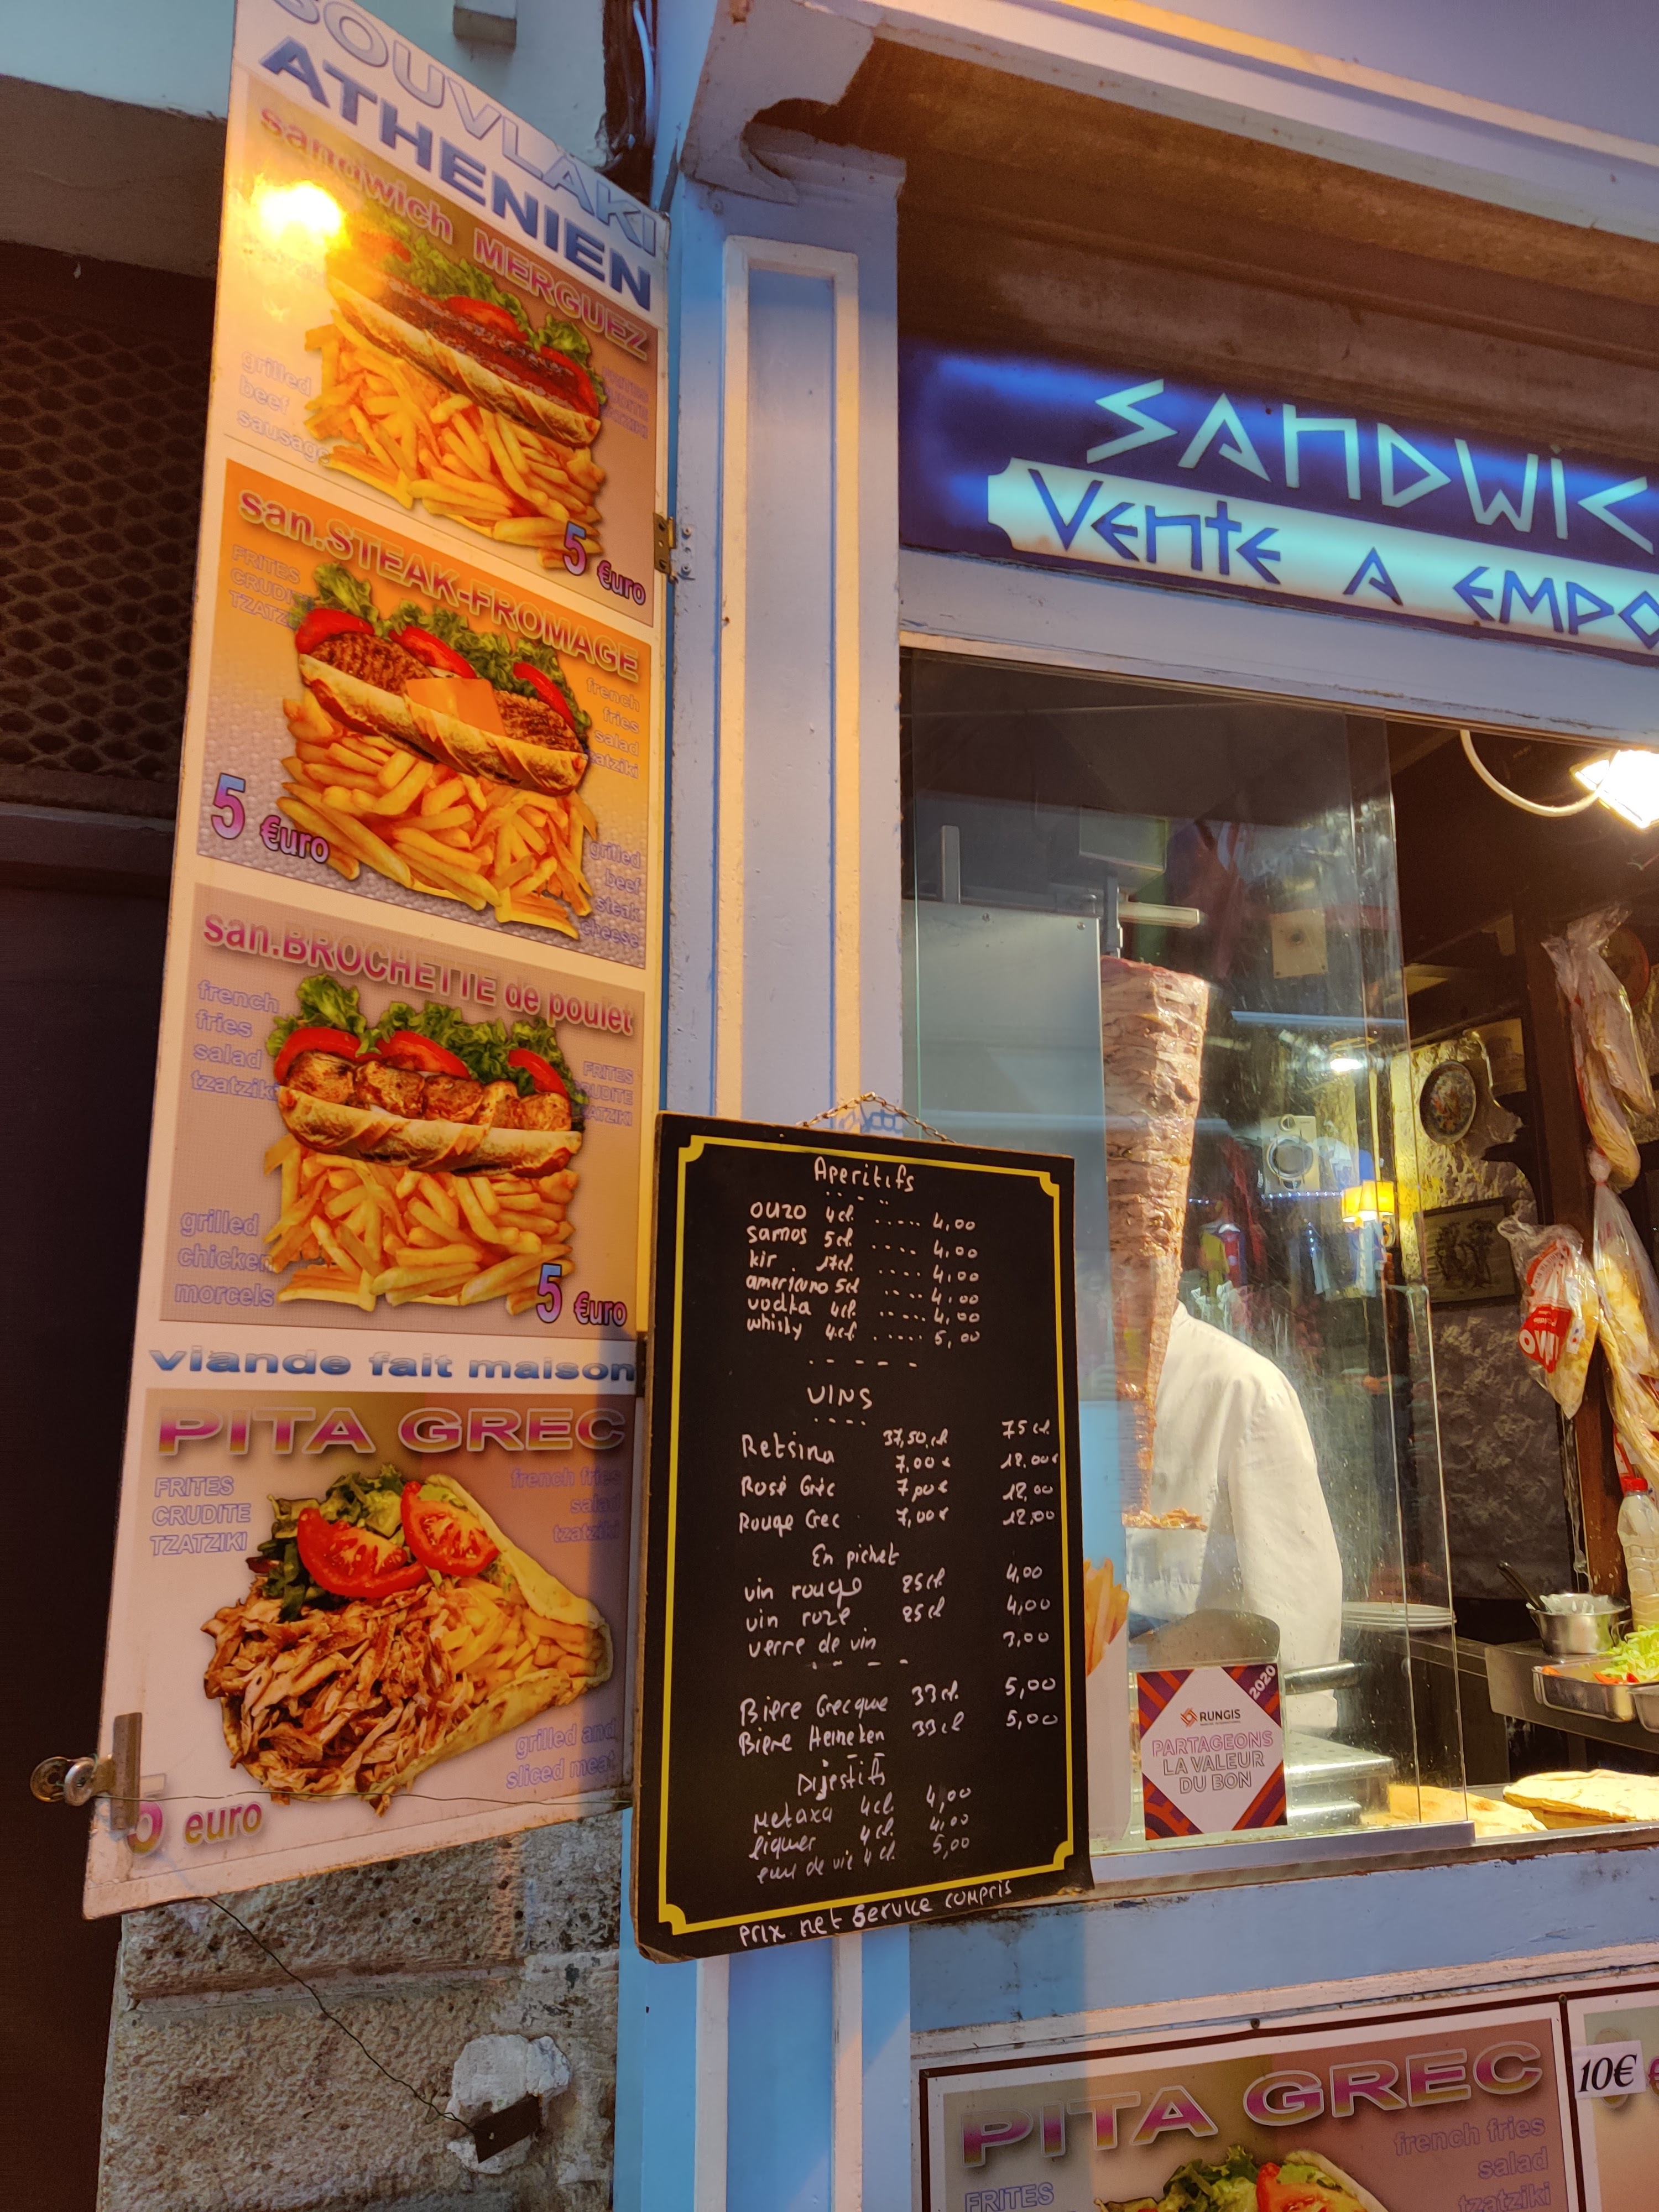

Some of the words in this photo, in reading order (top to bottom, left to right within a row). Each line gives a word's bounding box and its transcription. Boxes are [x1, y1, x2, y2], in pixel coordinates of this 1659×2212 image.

[259, 36, 651, 312] ATHENIEN
[261, 109, 453, 245] sandwich
[473, 228, 649, 362] MERGUEZ
[241, 351, 312, 397] grilled
[239, 375, 290, 415] beef
[563, 521, 587, 576] 5
[231, 544, 301, 585] FRITES
[1343, 547, 1403, 606] A
[587, 677, 640, 712] french
[603, 707, 639, 734] fries
[594, 730, 639, 757] salad
[211, 773, 246, 840] 5
[590, 841, 641, 869] grilled
[606, 868, 641, 895] beef
[596, 896, 640, 922] steak
[581, 917, 639, 948] cheese
[197, 979, 280, 1014] french
[505, 982, 540, 1015] de
[547, 992, 634, 1036] poulet
[195, 1009, 252, 1038] fries
[194, 1043, 262, 1070] salad
[583, 1060, 634, 1084] FRITES
[814, 1156, 915, 1192] Aperitifs
[180, 1209, 259, 1237] grilled
[178, 1243, 275, 1272] chicken
[174, 1284, 275, 1307] morcels
[536, 1262, 562, 1323] 5
[747, 1292, 812, 1315] vodka
[149, 1345, 351, 1376] viande
[368, 1352, 452, 1378] fait
[468, 1357, 635, 1381] maison
[157, 1406, 377, 1455] PITA
[398, 1406, 626, 1453] GREC
[154, 1476, 234, 1498] FRITES
[511, 1468, 575, 1489] french
[152, 1503, 252, 1526] CRUDITE
[150, 1531, 248, 1556] TZATZIKI
[812, 1543, 834, 1568] En
[744, 1577, 774, 1602] vin
[1006, 1563, 1043, 1584] 4,00
[747, 1608, 779, 1632] vin
[1006, 1594, 1051, 1616] 4,00
[749, 1637, 806, 1658] verre
[818, 1632, 841, 1653] de
[851, 1627, 877, 1651] vin
[1005, 1676, 1056, 1700] 5,00
[1249, 1664, 1276, 1701] 2020
[809, 1723, 885, 1752] Heineken
[1006, 1709, 1058, 1730] 5,00
[1199, 1709, 1240, 1722] RUNGIS
[515, 1723, 577, 1760] grilled
[582, 1718, 616, 1744] and
[1152, 1730, 1274, 1758] PARTAGEONS
[506, 1757, 565, 1790] sliced
[1162, 1757, 1188, 1776] LA
[1190, 1750, 1265, 1773] VALEUR
[1179, 1776, 1207, 1794] DU
[1212, 1770, 1252, 1792] BON
[184, 1801, 262, 1845] euro
[800, 1907, 842, 1937] net
[1578, 2053, 1637, 2093] 10€
[960, 2085, 1219, 2168] PITA
[1243, 2041, 1545, 2126] GREC
[1394, 2122, 1480, 2156] french
[1486, 2116, 1546, 2143] fries
[1478, 2146, 1549, 2179] salad
[964, 2182, 1055, 2212] FRITES
[1458, 2182, 1552, 2212] tzatziki
